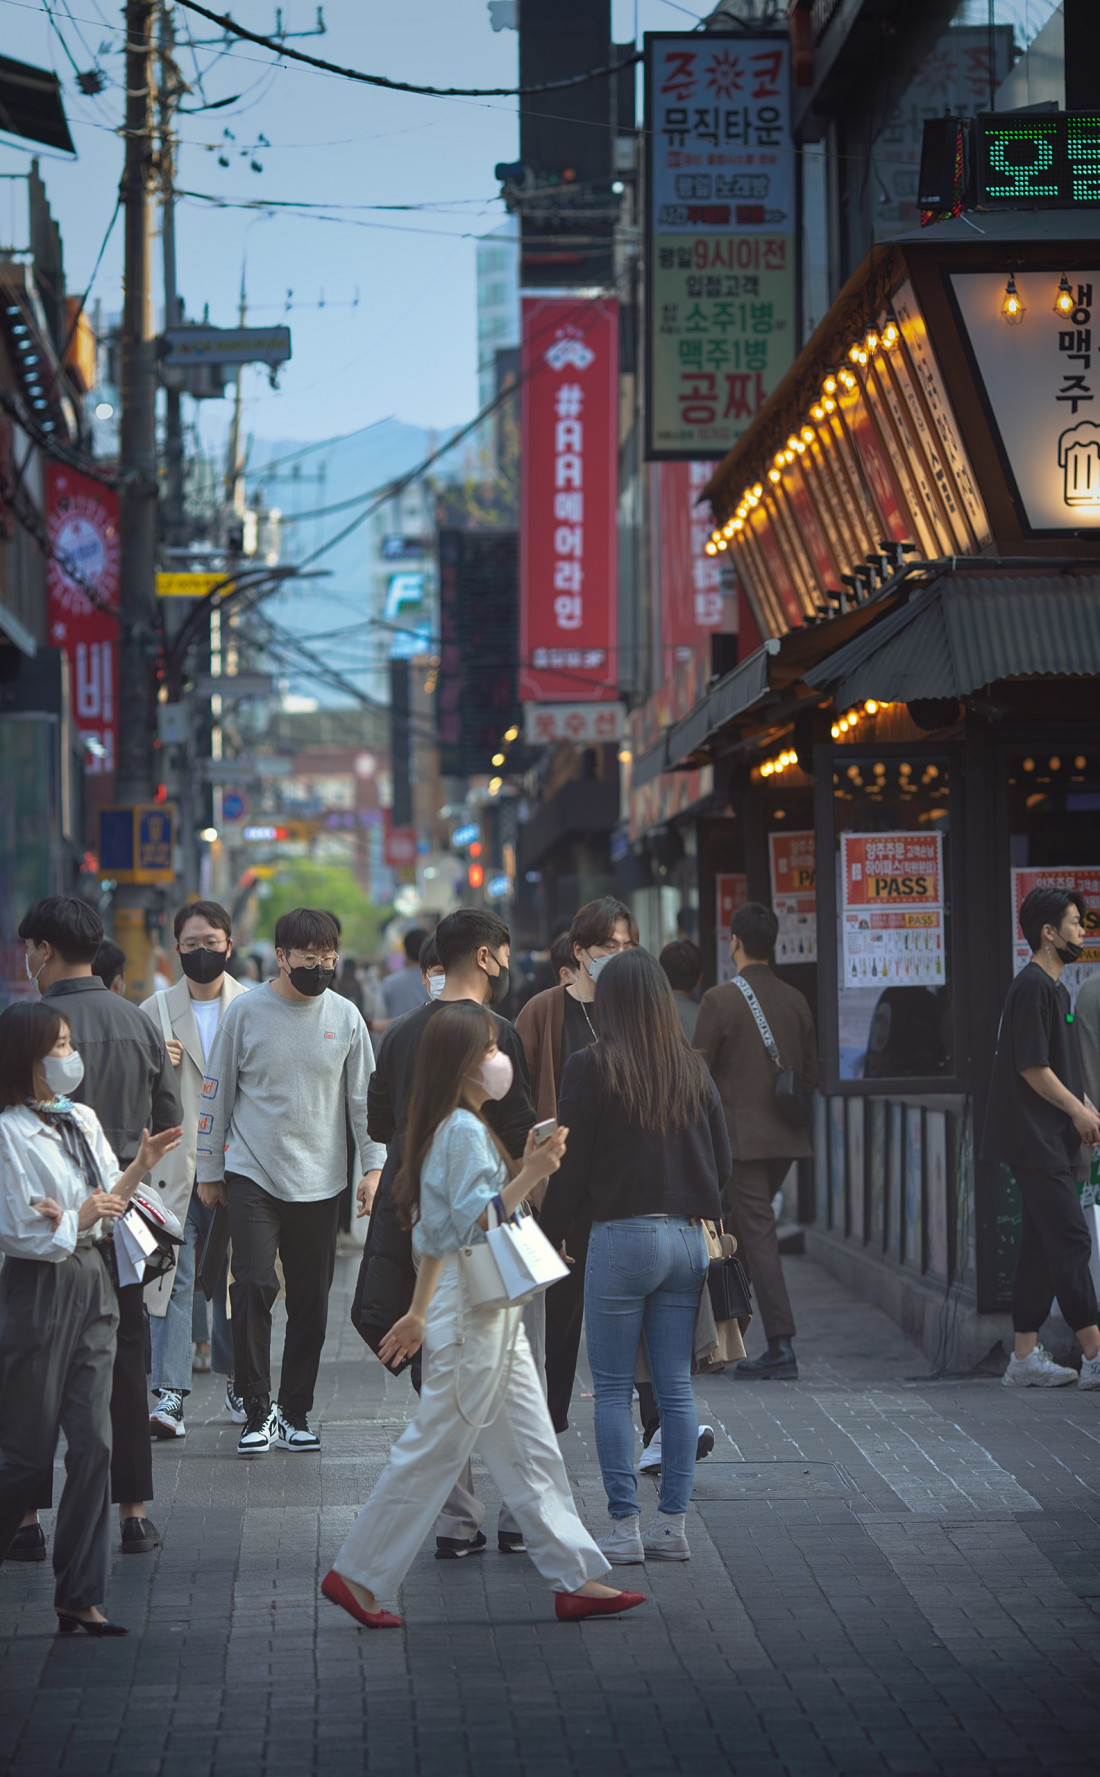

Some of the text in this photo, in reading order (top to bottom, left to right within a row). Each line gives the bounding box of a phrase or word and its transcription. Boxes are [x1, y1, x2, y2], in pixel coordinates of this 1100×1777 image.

[662, 105, 784, 147] 뮤직타운
[684, 302, 774, 334] 소주1병
[678, 339, 768, 371] 맥주1병
[678, 372, 768, 425] 공짜
[875, 877, 928, 896] PASS
[908, 915, 935, 926] PASS
